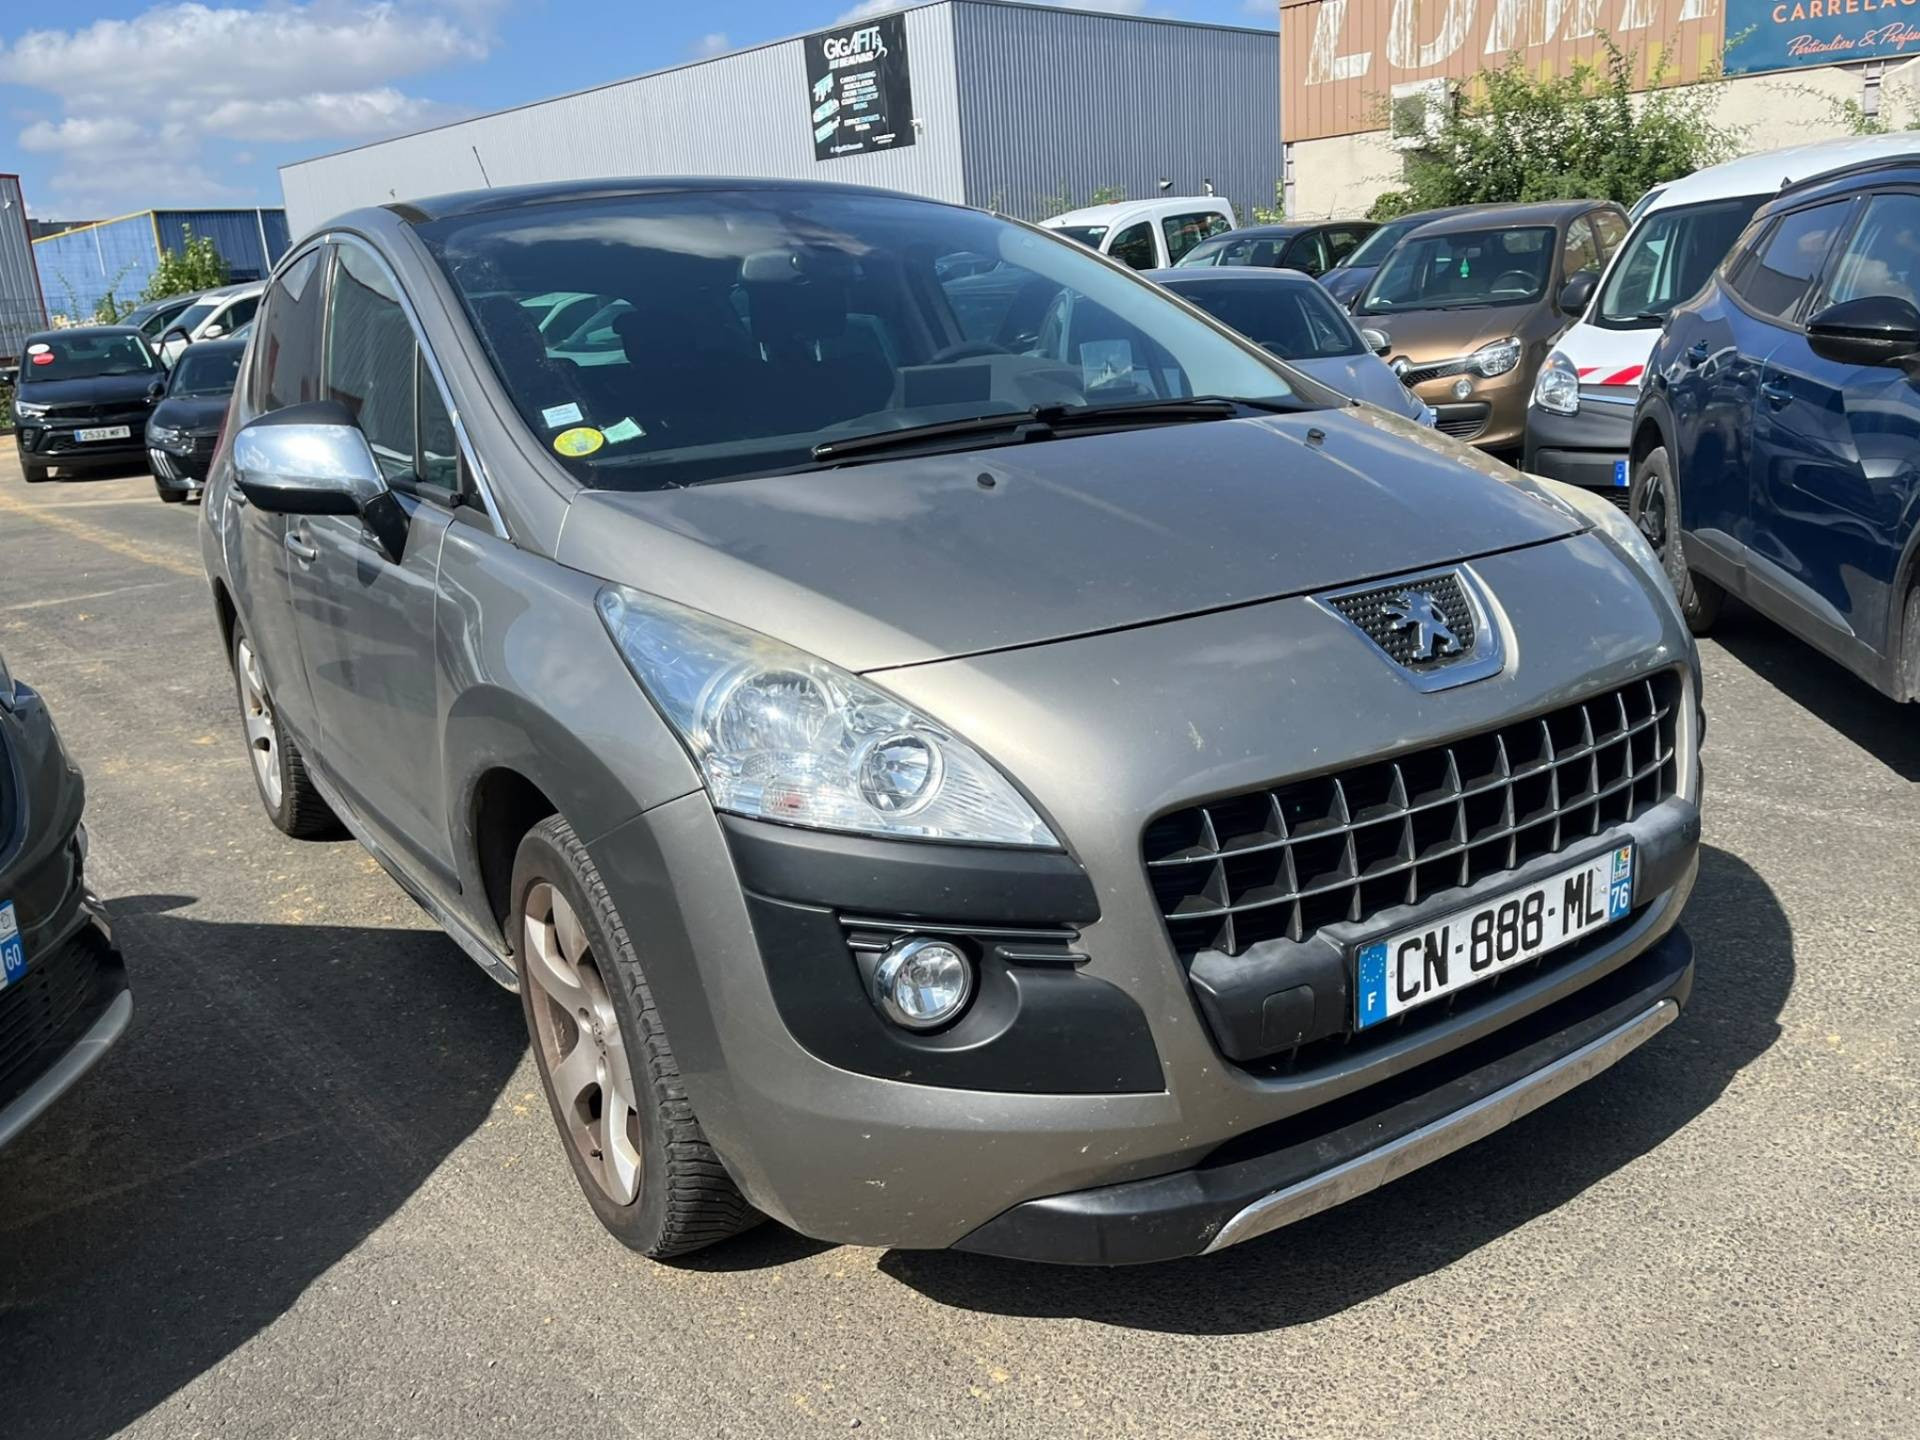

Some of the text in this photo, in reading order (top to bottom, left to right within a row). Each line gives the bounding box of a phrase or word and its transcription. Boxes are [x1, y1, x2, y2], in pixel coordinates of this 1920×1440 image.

[823, 25, 880, 60] GIGAFIT
[1611, 881, 1629, 913] 76
[1396, 869, 1604, 1002] CN-888-ML
[5, 943, 21, 971] 60
[1367, 991, 1377, 1011] F
